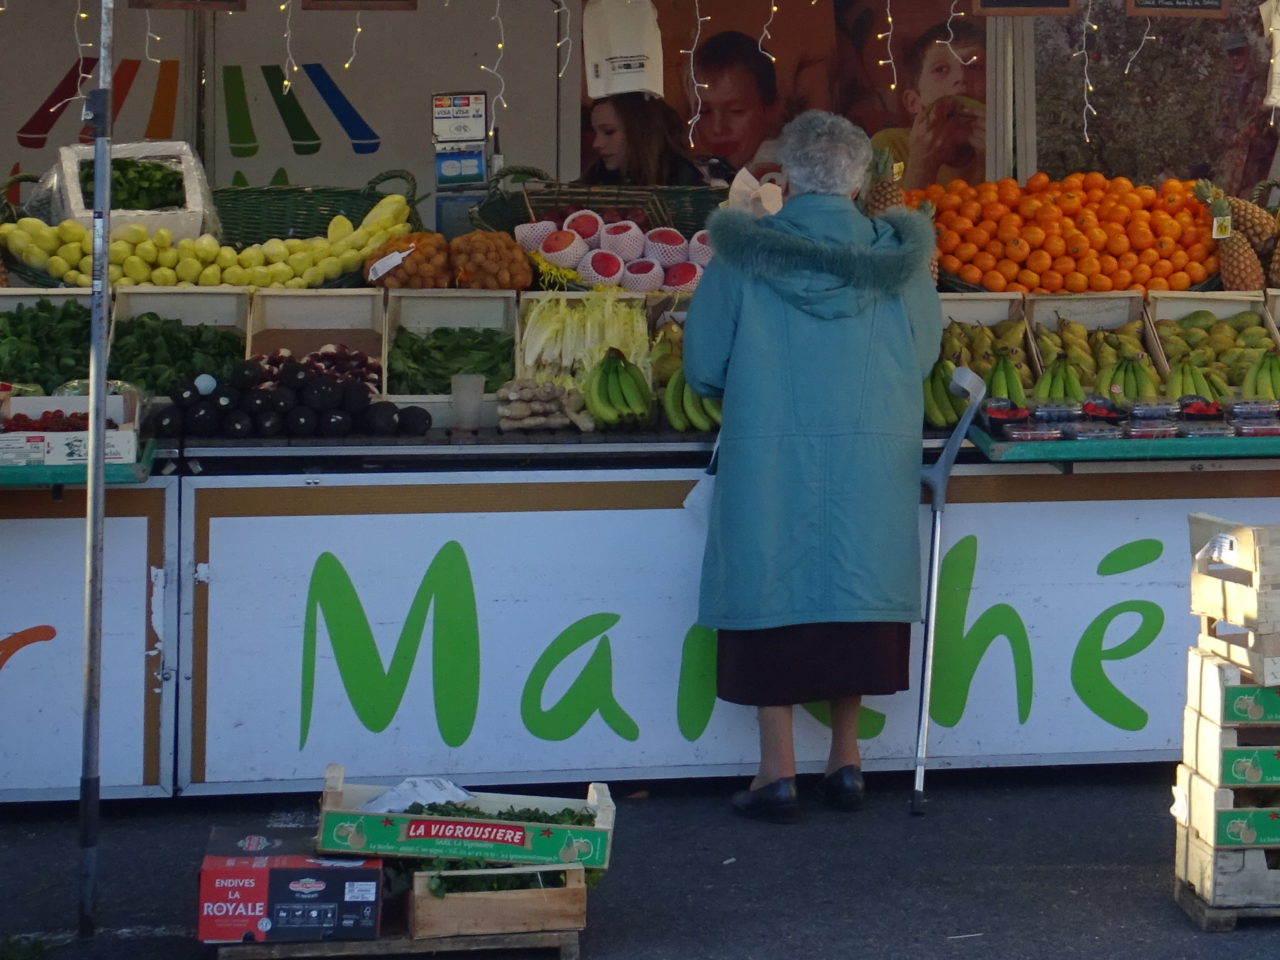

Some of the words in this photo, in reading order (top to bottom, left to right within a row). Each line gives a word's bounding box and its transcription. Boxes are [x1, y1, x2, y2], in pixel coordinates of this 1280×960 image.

[299, 534, 1164, 752] Mahé
[408, 824, 425, 837] LA
[430, 824, 524, 844] VIGROUSIERE
[215, 878, 255, 888] ENDIVES
[228, 891, 240, 899] LA
[203, 902, 264, 916] ROYALE
